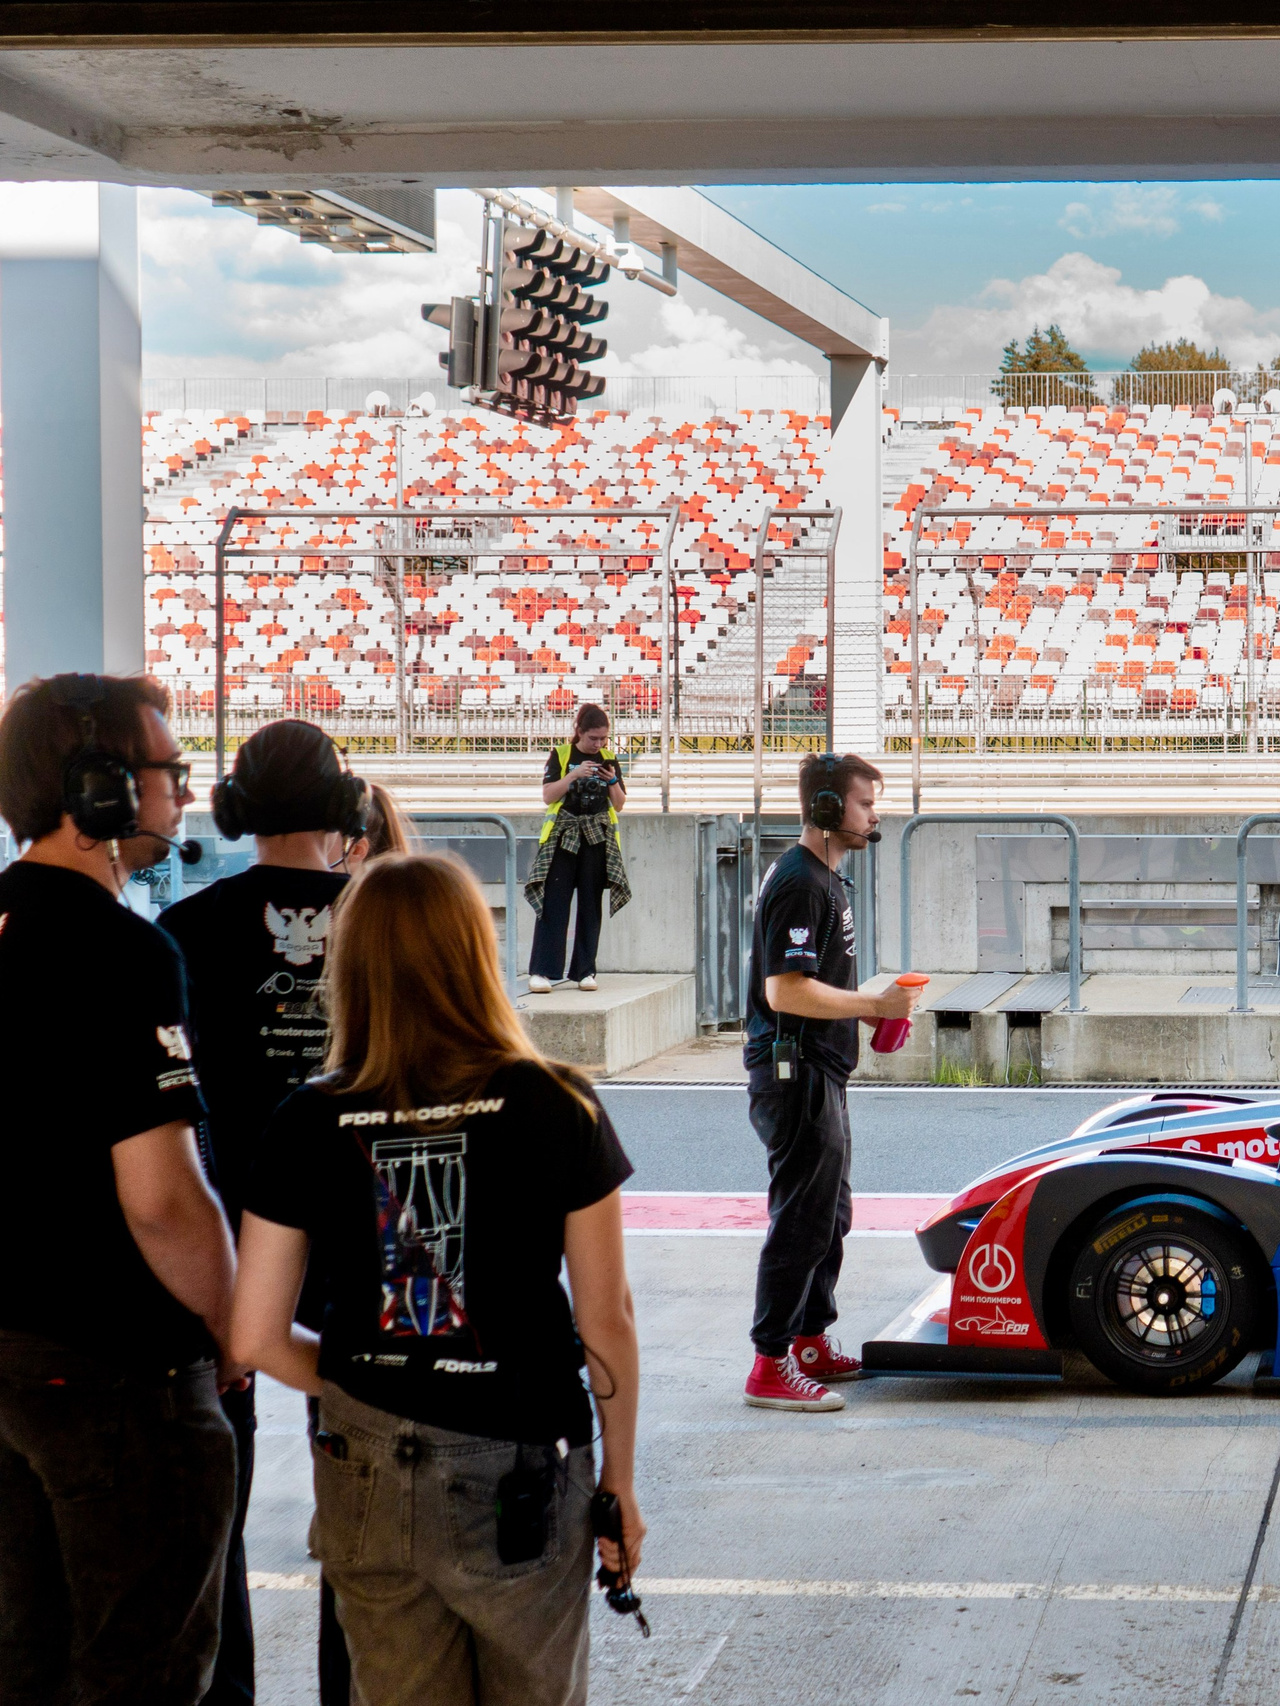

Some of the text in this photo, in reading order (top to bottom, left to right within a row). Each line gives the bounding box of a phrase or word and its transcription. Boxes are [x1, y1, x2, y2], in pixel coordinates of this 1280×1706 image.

[338, 1098, 505, 1127] FDR MOSCOW
[960, 1295, 1022, 1304] НИИ ПОЛИМЕРОВ
